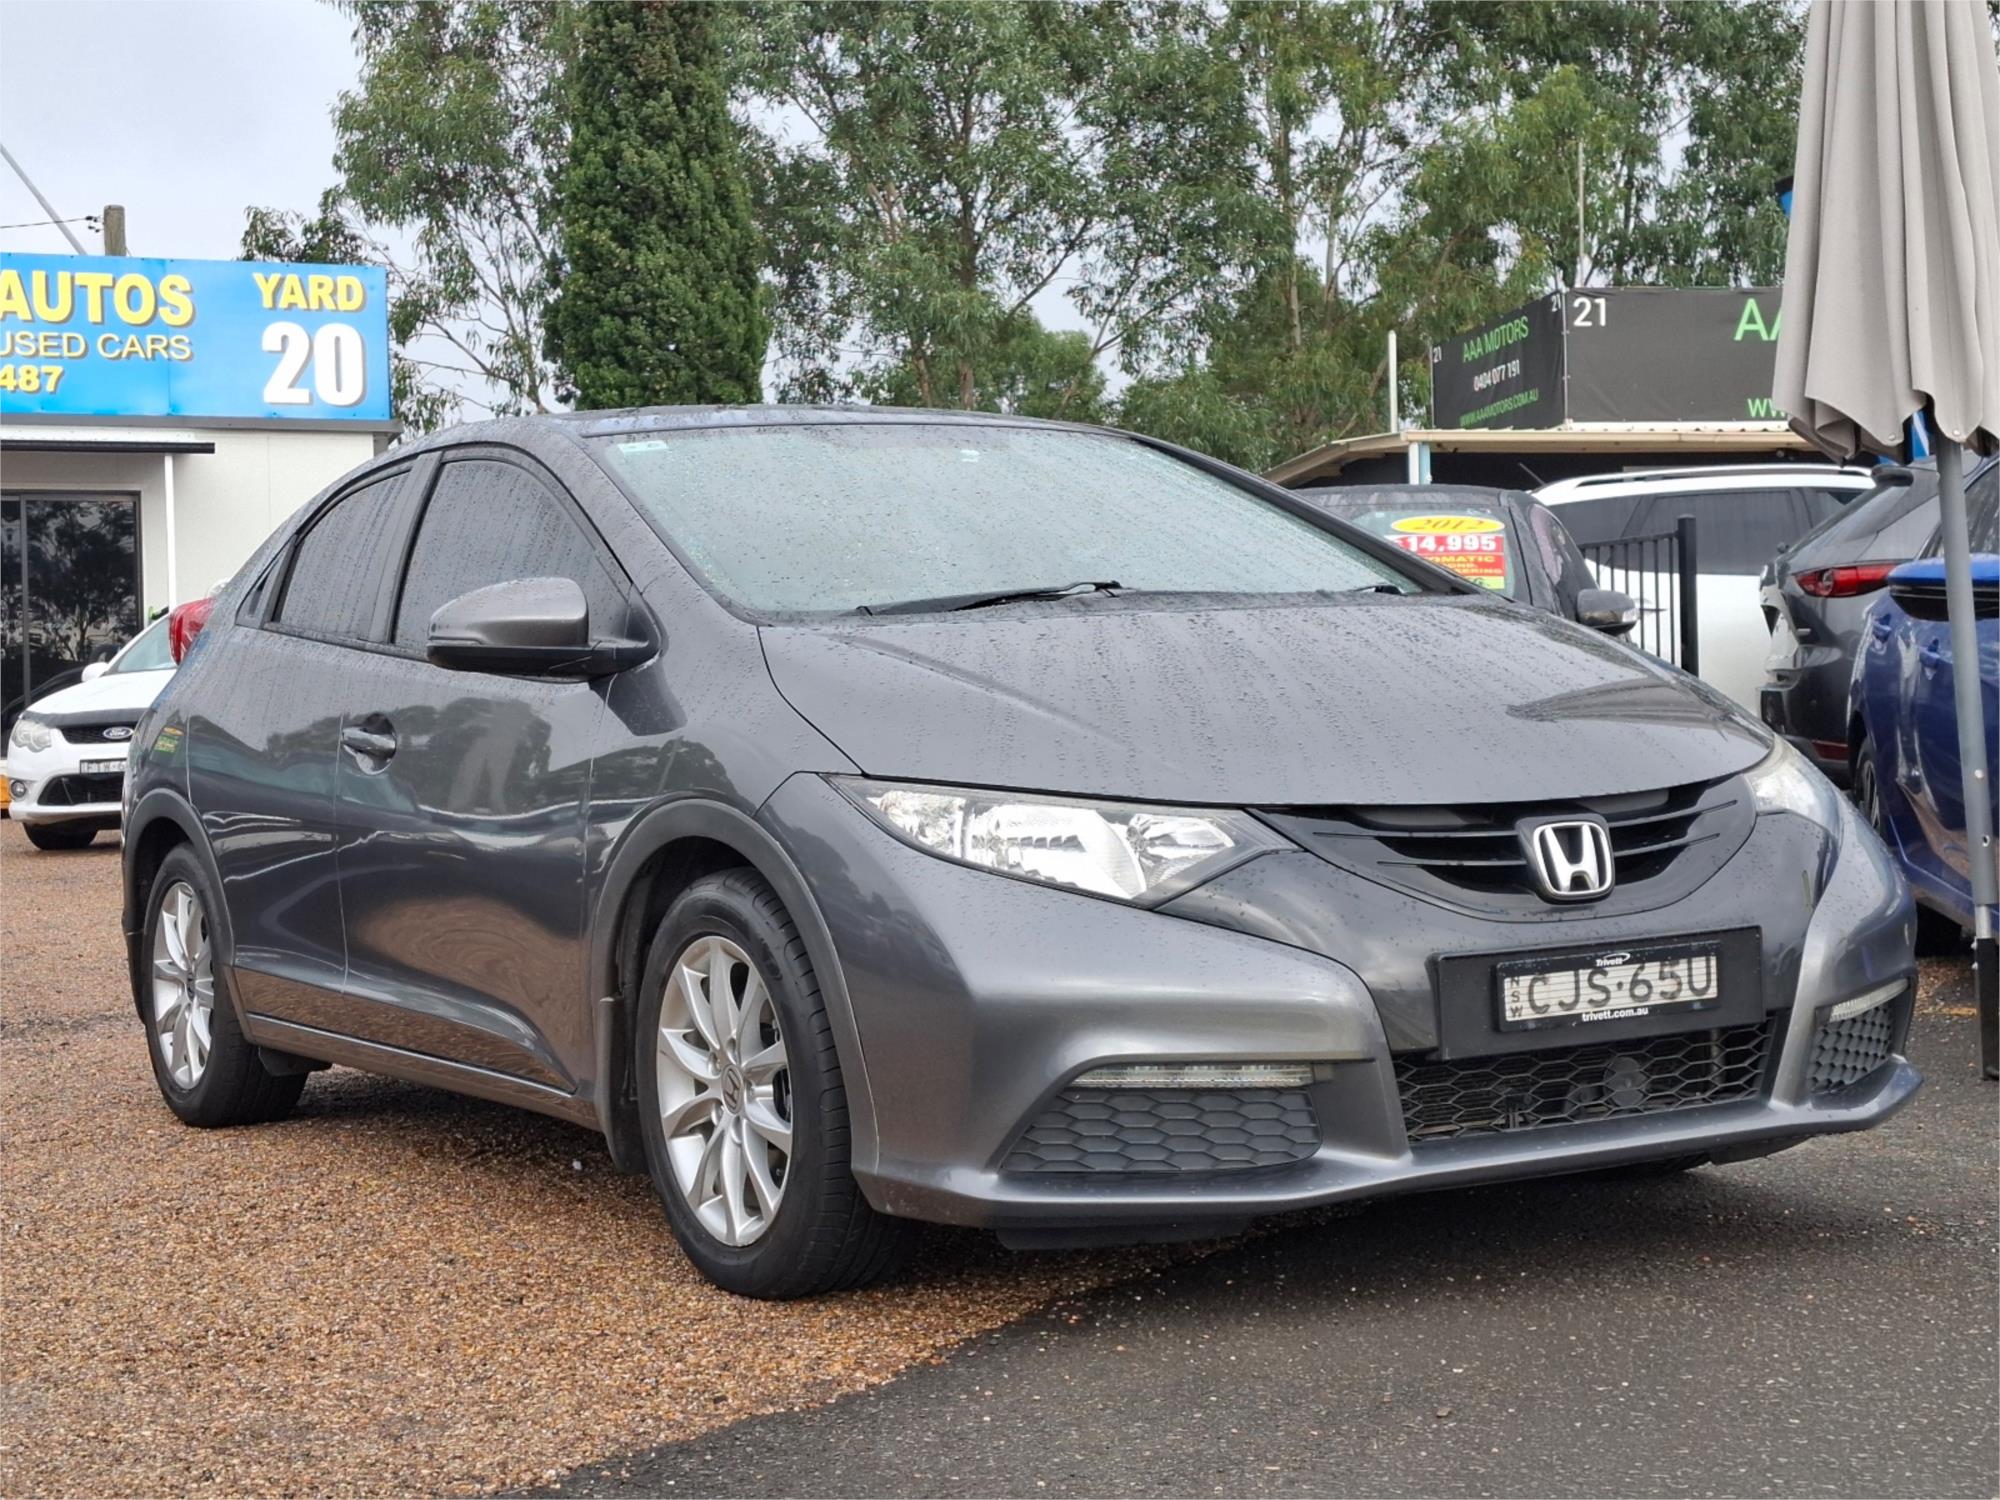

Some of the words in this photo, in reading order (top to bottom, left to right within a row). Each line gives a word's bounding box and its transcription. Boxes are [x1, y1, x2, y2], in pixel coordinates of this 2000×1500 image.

[0, 269, 194, 326] AUTOS
[252, 272, 365, 312] YARD
[1551, 295, 1562, 312] 21
[1573, 298, 1607, 327] 21
[97, 332, 192, 360] CARS
[1463, 336, 1484, 363] AAA
[1484, 316, 1529, 353] MOTORS
[262, 322, 365, 406] 20
[1433, 346, 1443, 363] 21
[0, 364, 64, 393] 487
[1397, 534, 1497, 552] 14,995
[1582, 1007, 1648, 1022] trivett.com.au
